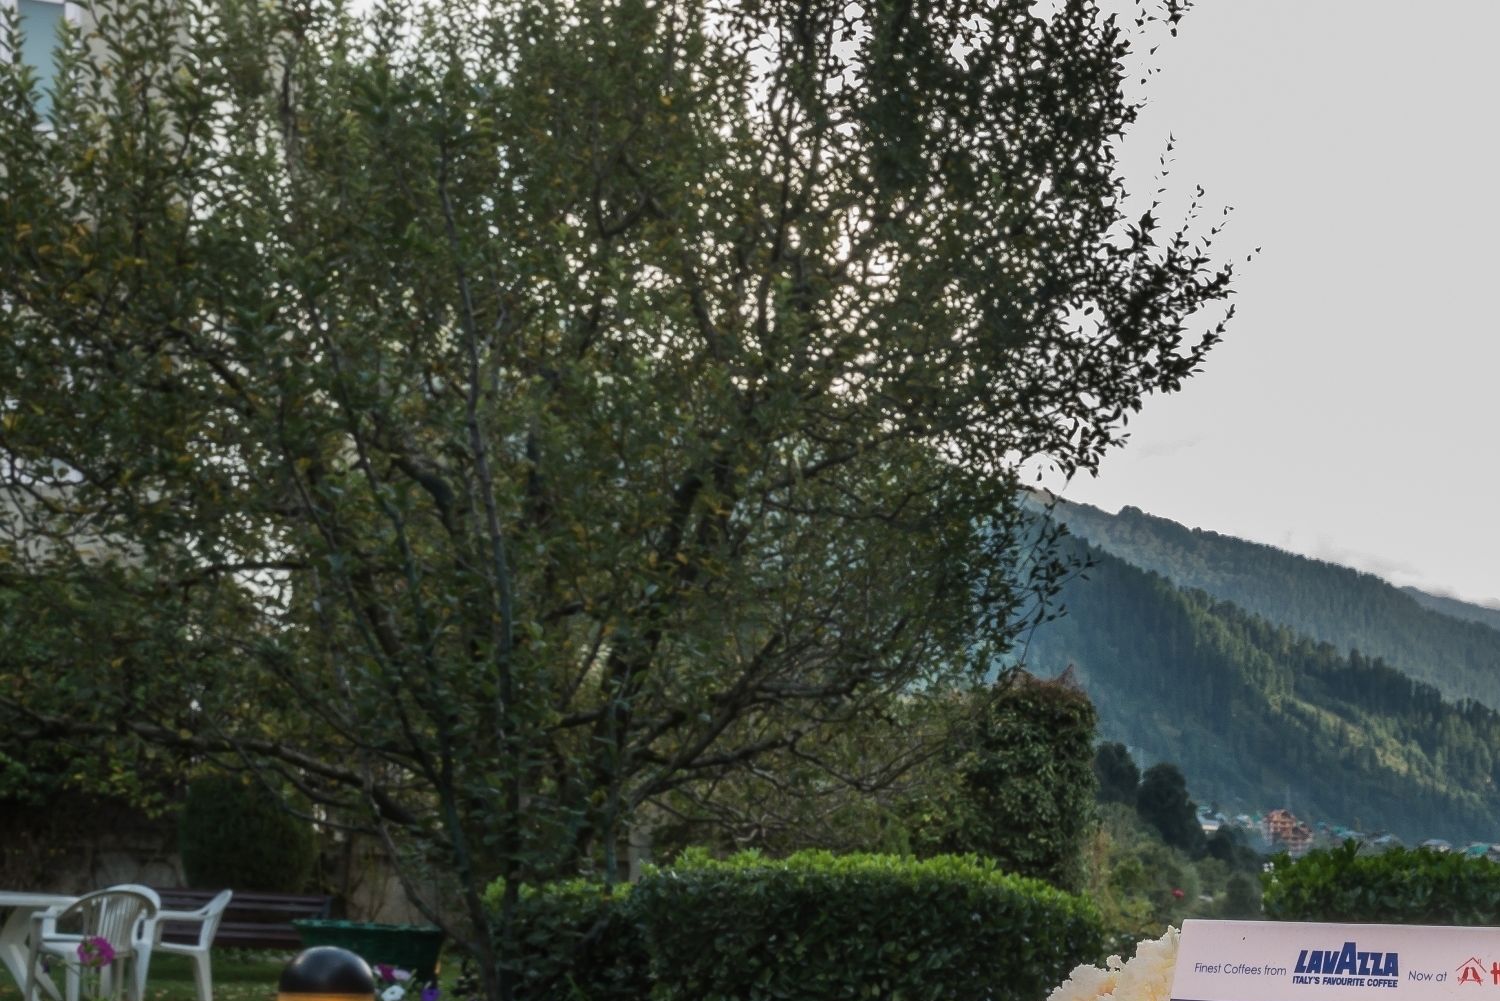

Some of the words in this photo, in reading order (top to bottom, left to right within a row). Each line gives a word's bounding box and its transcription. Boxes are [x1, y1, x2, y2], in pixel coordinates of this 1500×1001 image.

[1294, 942, 1399, 977] LAVAZZA
[1194, 962, 1221, 974] Finest
[1223, 963, 1262, 976] Coffees
[1263, 965, 1287, 976] from
[1292, 975, 1320, 985] ITALY'S
[1322, 976, 1365, 987] FAVOURITE
[1367, 978, 1398, 988] COFFEE
[1408, 970, 1433, 982] Now
[1435, 971, 1447, 982] at
